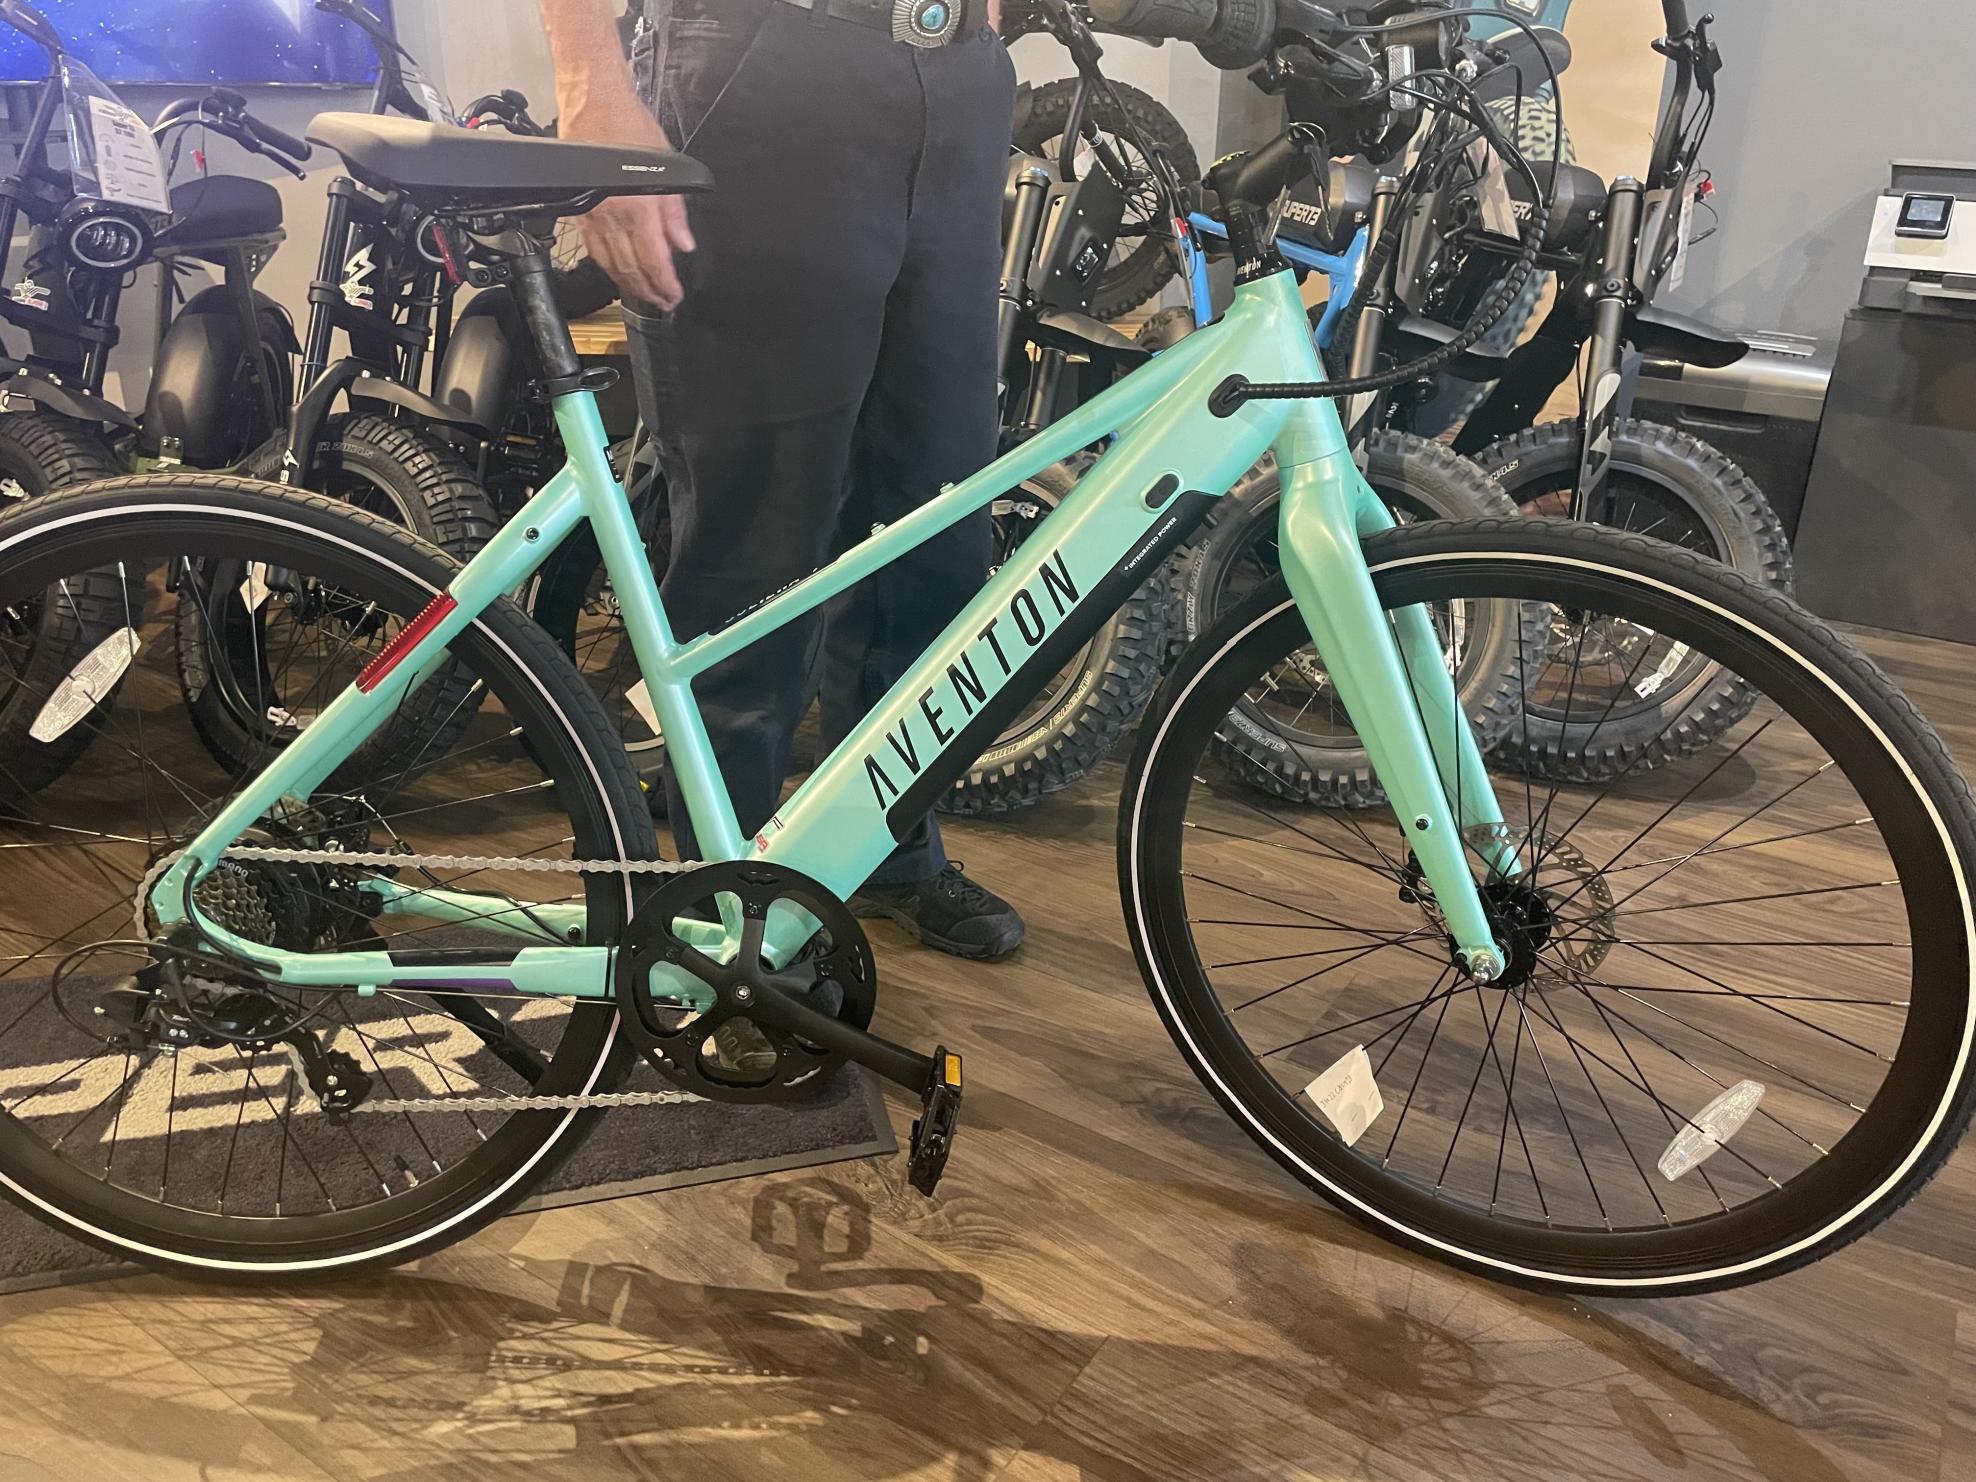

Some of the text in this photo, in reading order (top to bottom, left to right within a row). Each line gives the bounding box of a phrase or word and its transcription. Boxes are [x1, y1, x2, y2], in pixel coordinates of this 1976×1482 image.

[1281, 199, 1322, 226] UPER73
[1128, 516, 1177, 569] INTEGRATED POWER
[863, 549, 1080, 811] AVENTON
